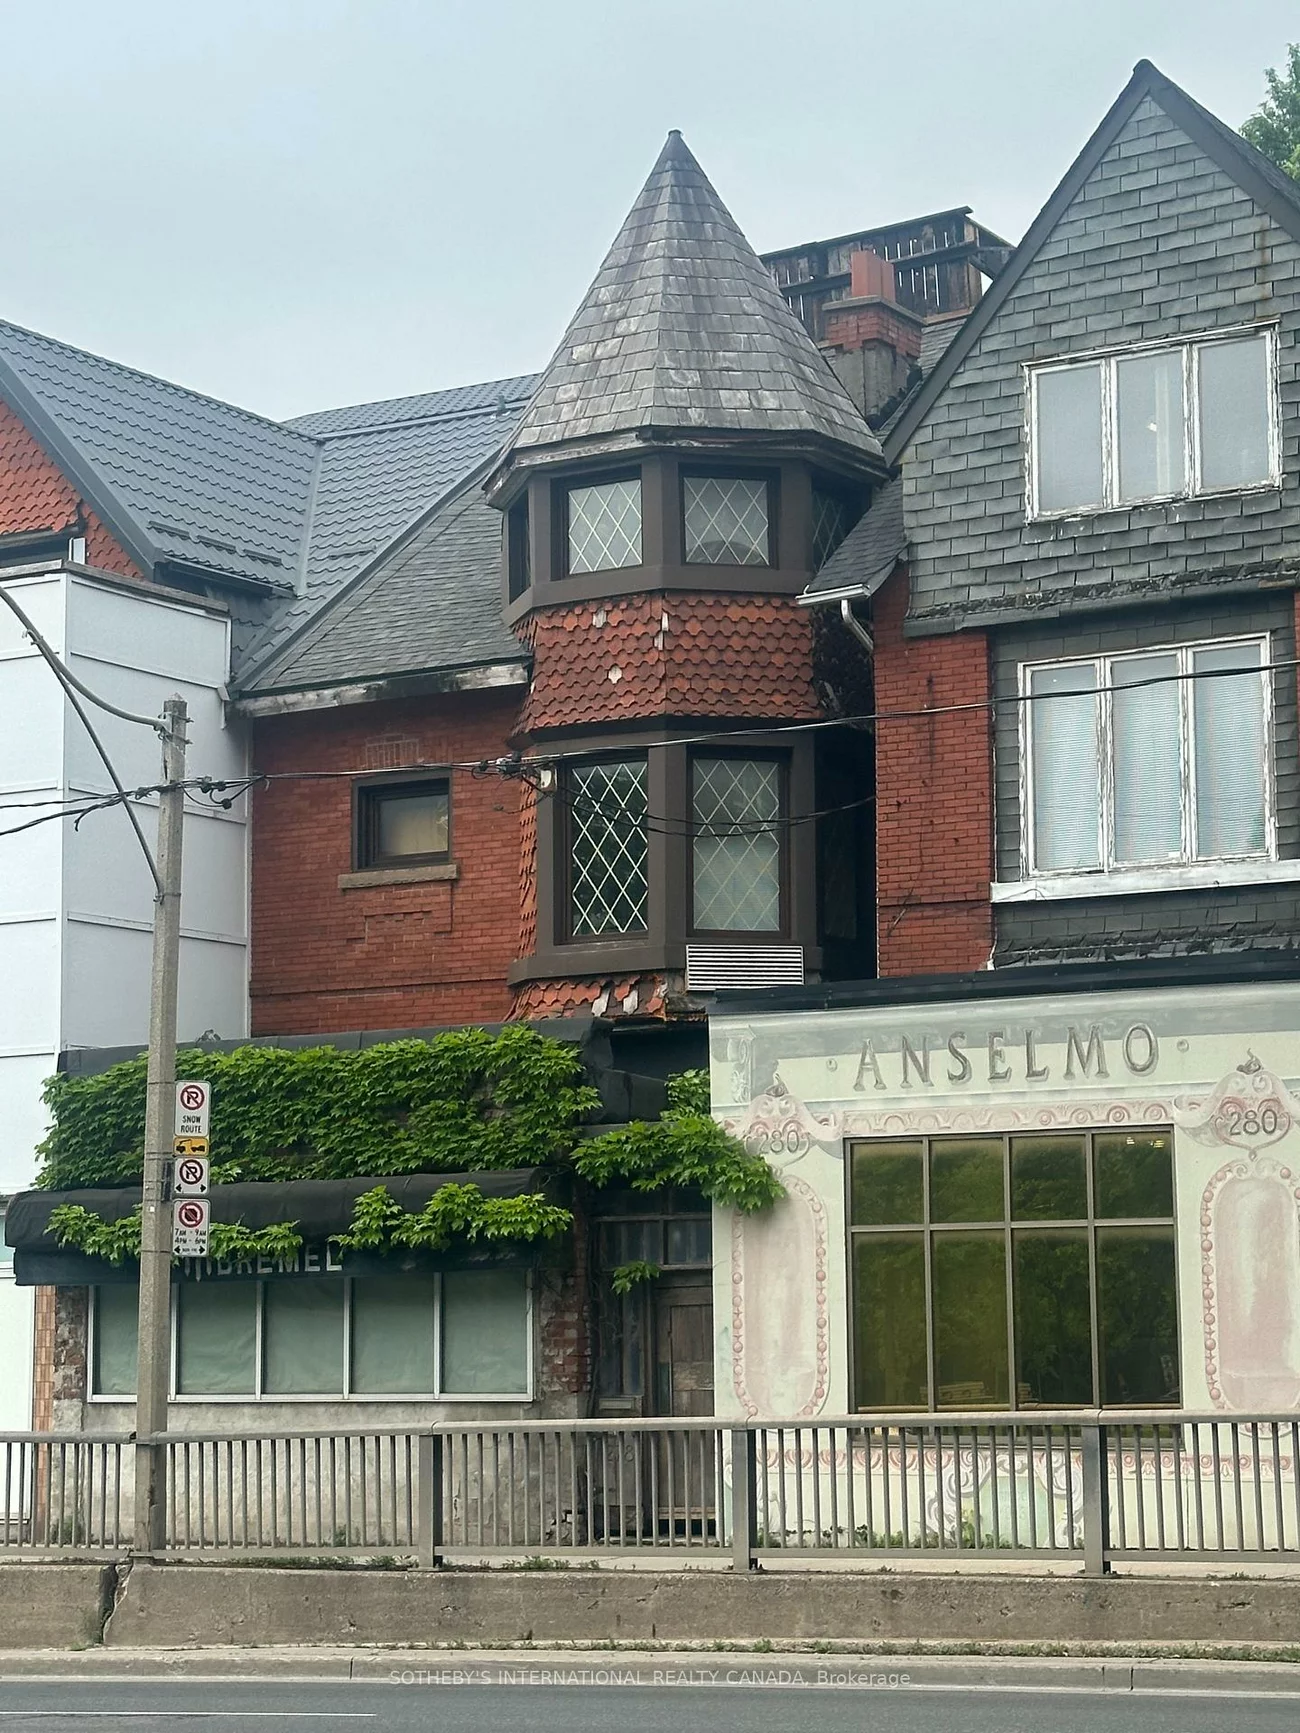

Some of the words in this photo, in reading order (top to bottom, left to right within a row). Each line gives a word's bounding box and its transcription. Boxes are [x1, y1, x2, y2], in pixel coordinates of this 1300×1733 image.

[853, 1022, 1159, 1090] ANSELMO
[180, 1125, 202, 1133] ROUTE
[182, 1115, 202, 1123] SNOW
[1230, 1108, 1278, 1135] 280
[758, 1129, 799, 1153] 280
